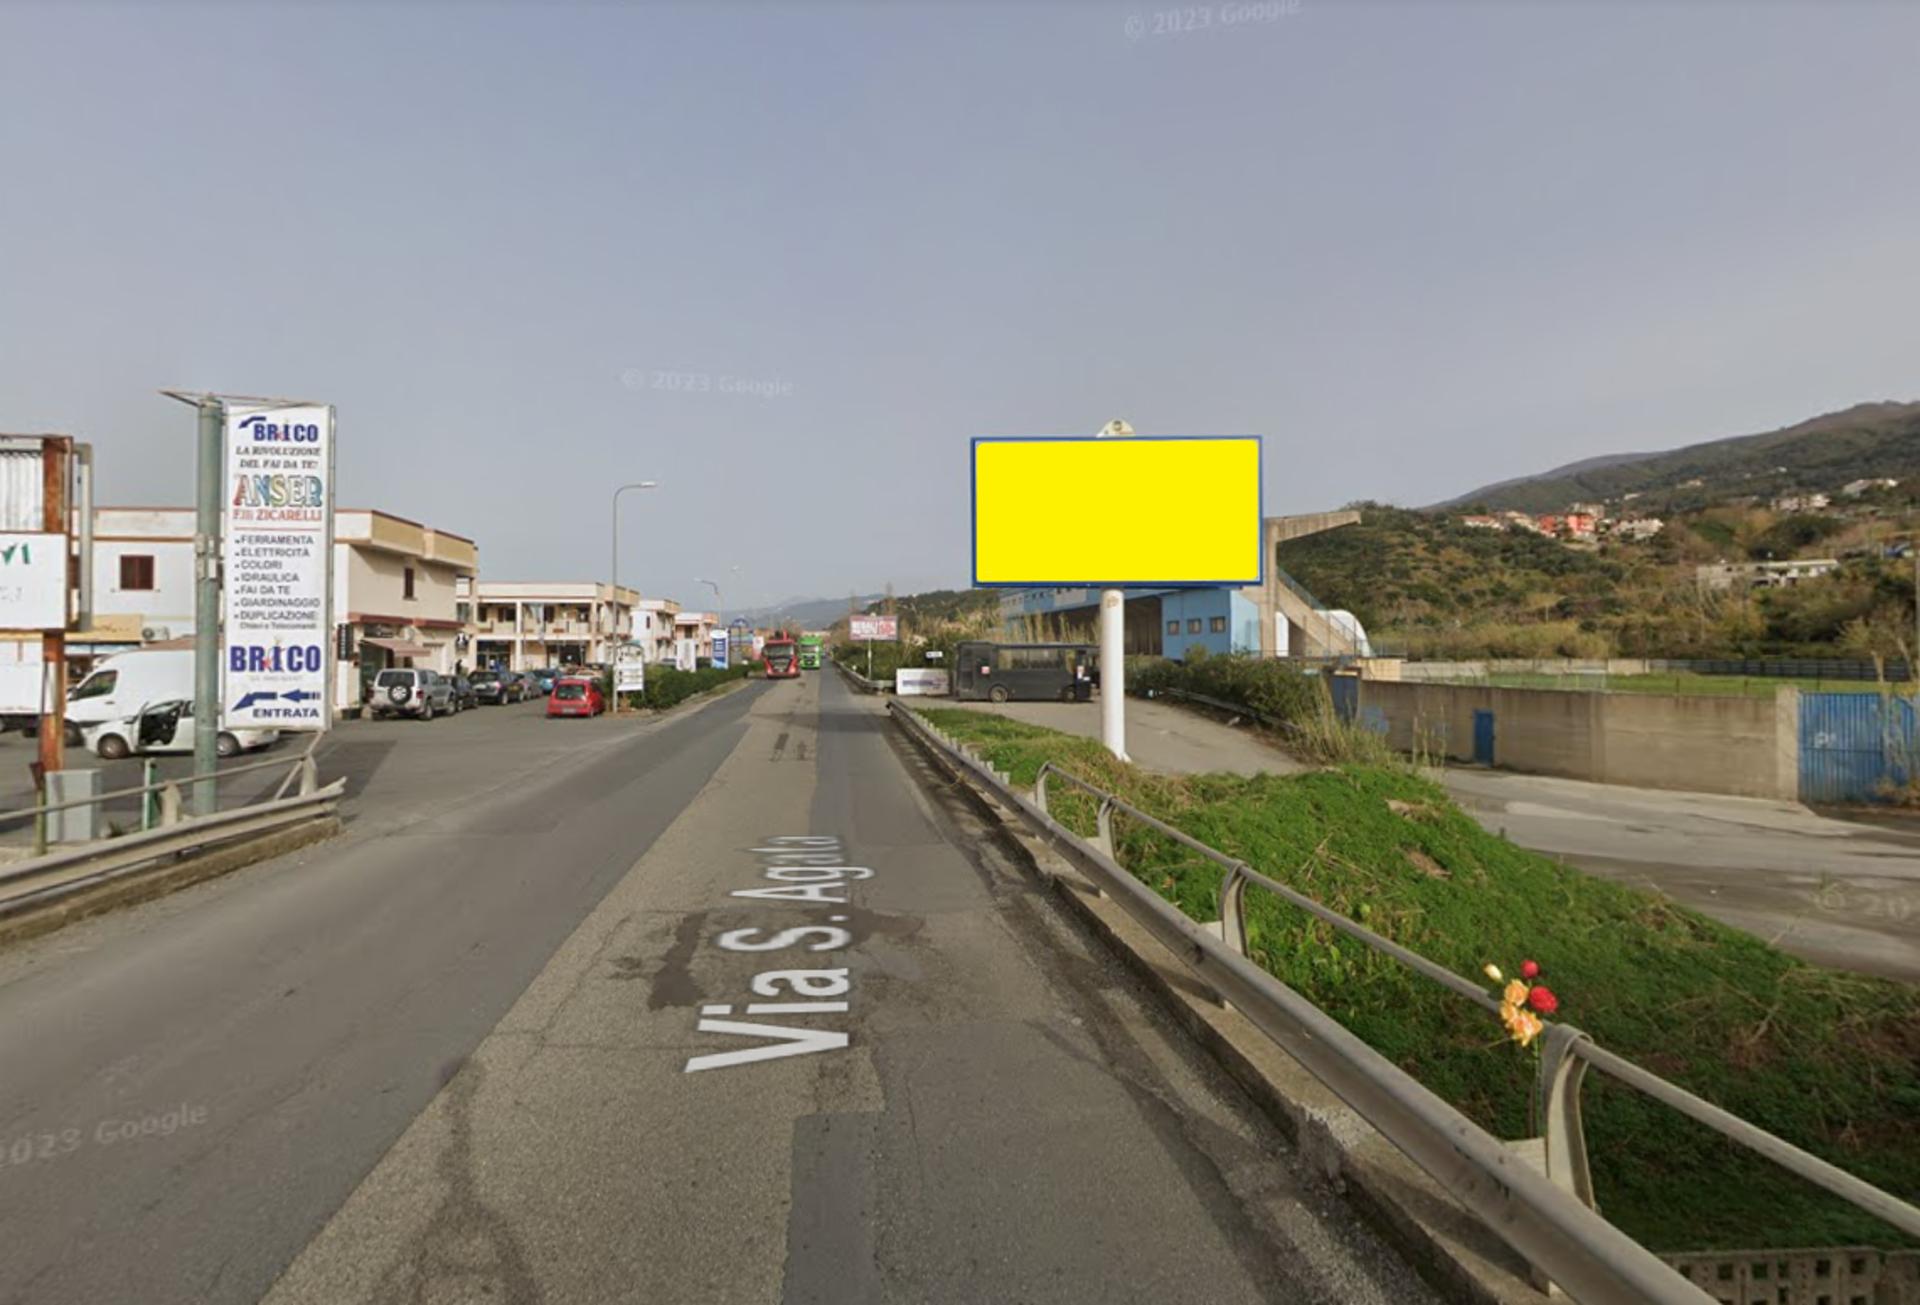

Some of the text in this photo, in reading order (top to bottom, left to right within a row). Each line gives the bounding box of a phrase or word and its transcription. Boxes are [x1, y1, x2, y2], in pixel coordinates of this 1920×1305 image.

[253, 423, 319, 442] BRICO
[236, 446, 322, 457] LA RIVOLUZIONE
[240, 458, 260, 469] DEL
[262, 458, 281, 469] FAI
[283, 459, 298, 470] DA
[233, 475, 322, 507] ANSER
[256, 509, 322, 522] ZICARELLI
[241, 535, 314, 545] FERRAMENTA
[241, 560, 283, 570] COLORI
[241, 572, 300, 583] IDRAULICA
[240, 585, 290, 595] FAI DA TE
[240, 597, 321, 608] GIARDINAGGIO
[230, 645, 321, 673] BRICO
[252, 707, 319, 718] ENTRATA
